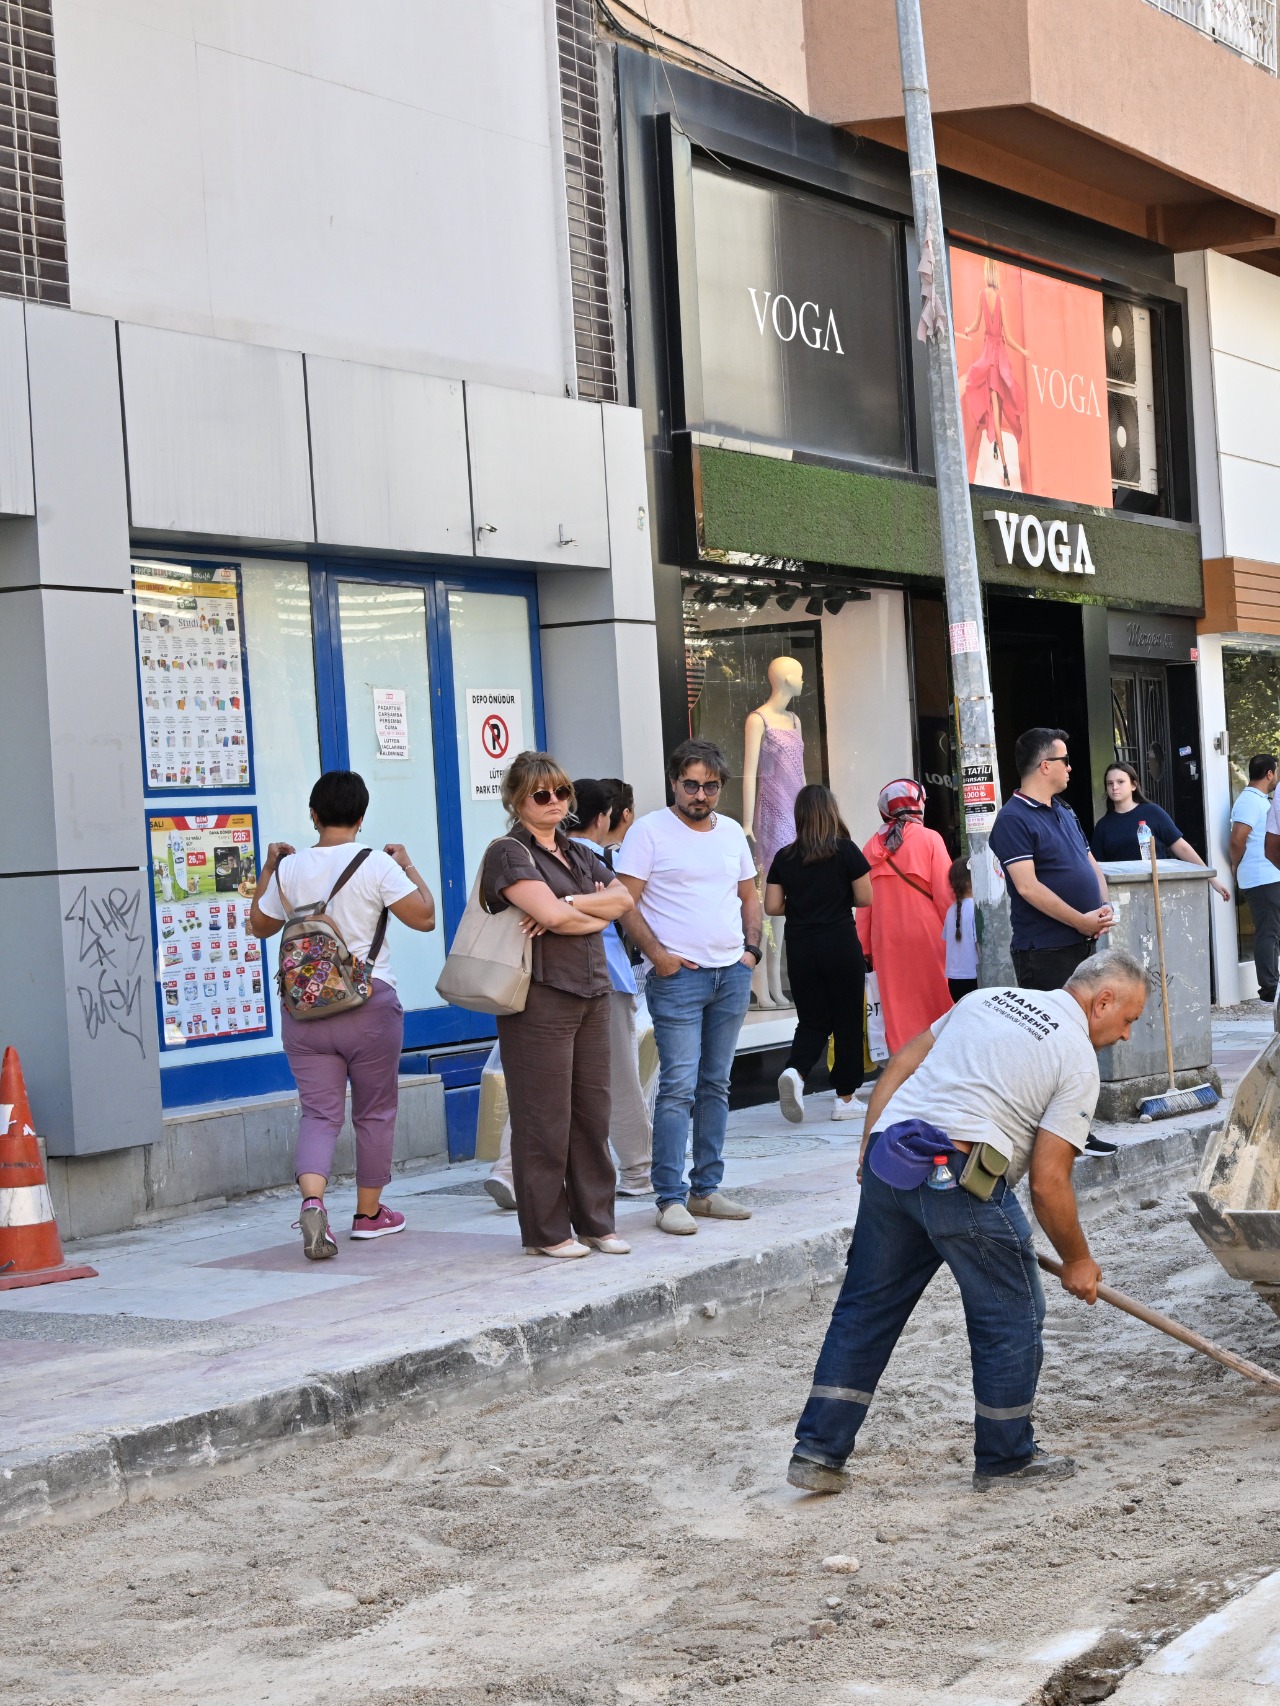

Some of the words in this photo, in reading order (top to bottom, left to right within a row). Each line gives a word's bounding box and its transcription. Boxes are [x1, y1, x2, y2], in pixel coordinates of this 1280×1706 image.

[747, 287, 845, 355] VOGA
[1031, 364, 1102, 418] VOGA
[983, 509, 1096, 575] VOGA
[472, 695, 487, 704] DEPO
[488, 693, 515, 704] ÖNÜDÜR
[475, 785, 491, 794] PARK
[489, 768, 505, 779] LÜTF
[233, 832, 246, 842] 235
[990, 995, 1051, 1036] BÜYÜKŞEHİR
[1002, 990, 1060, 1031] MANİSA
